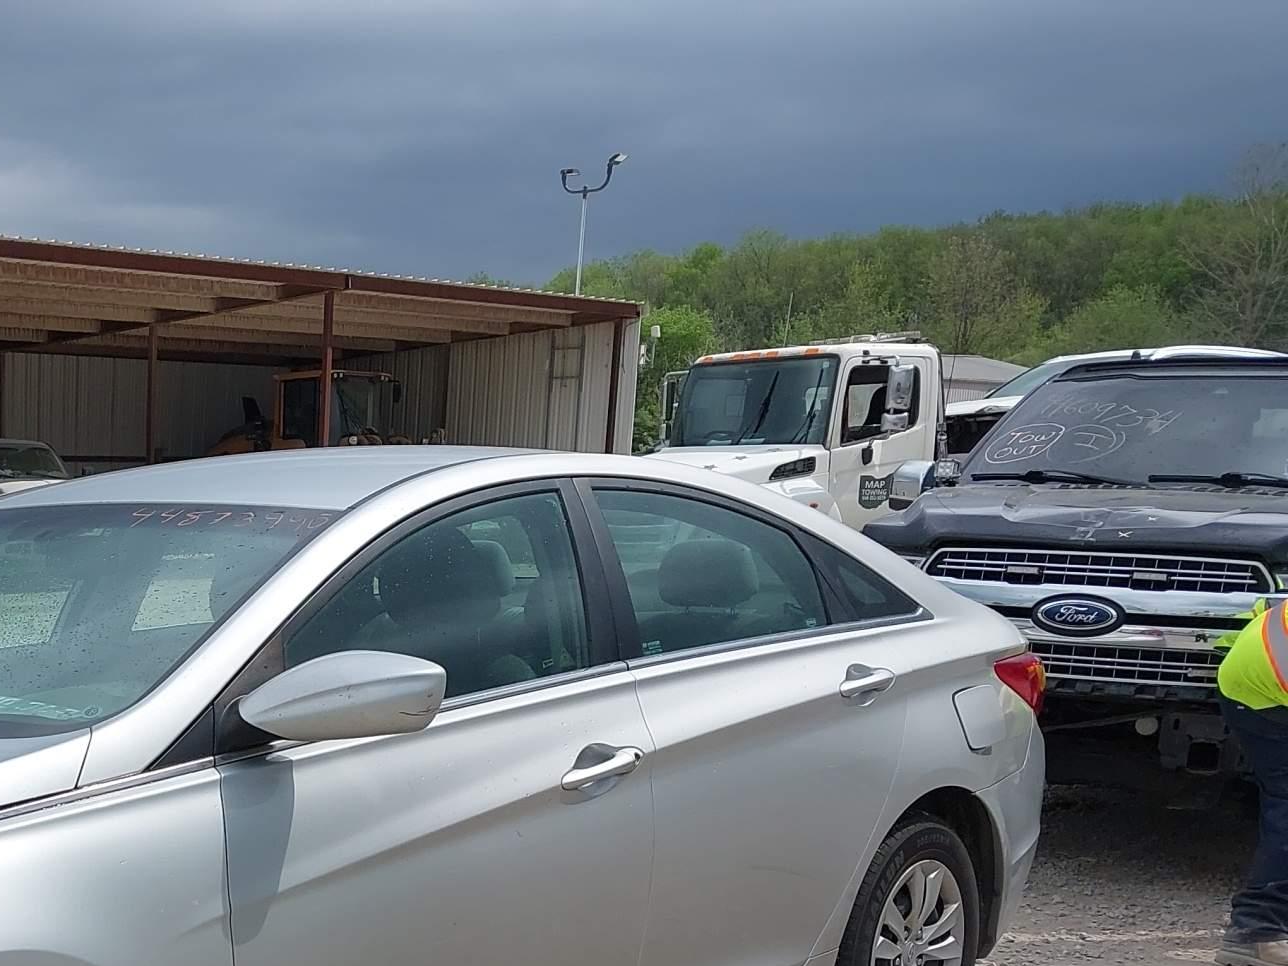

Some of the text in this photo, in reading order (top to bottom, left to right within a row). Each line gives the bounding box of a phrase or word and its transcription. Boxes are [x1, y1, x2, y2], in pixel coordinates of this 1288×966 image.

[1006, 430, 1056, 445] TOW
[993, 444, 1045, 459] OUT
[862, 488, 888, 496] TOWING
[865, 480, 886, 489] MAP
[1054, 605, 1099, 624] Ford
